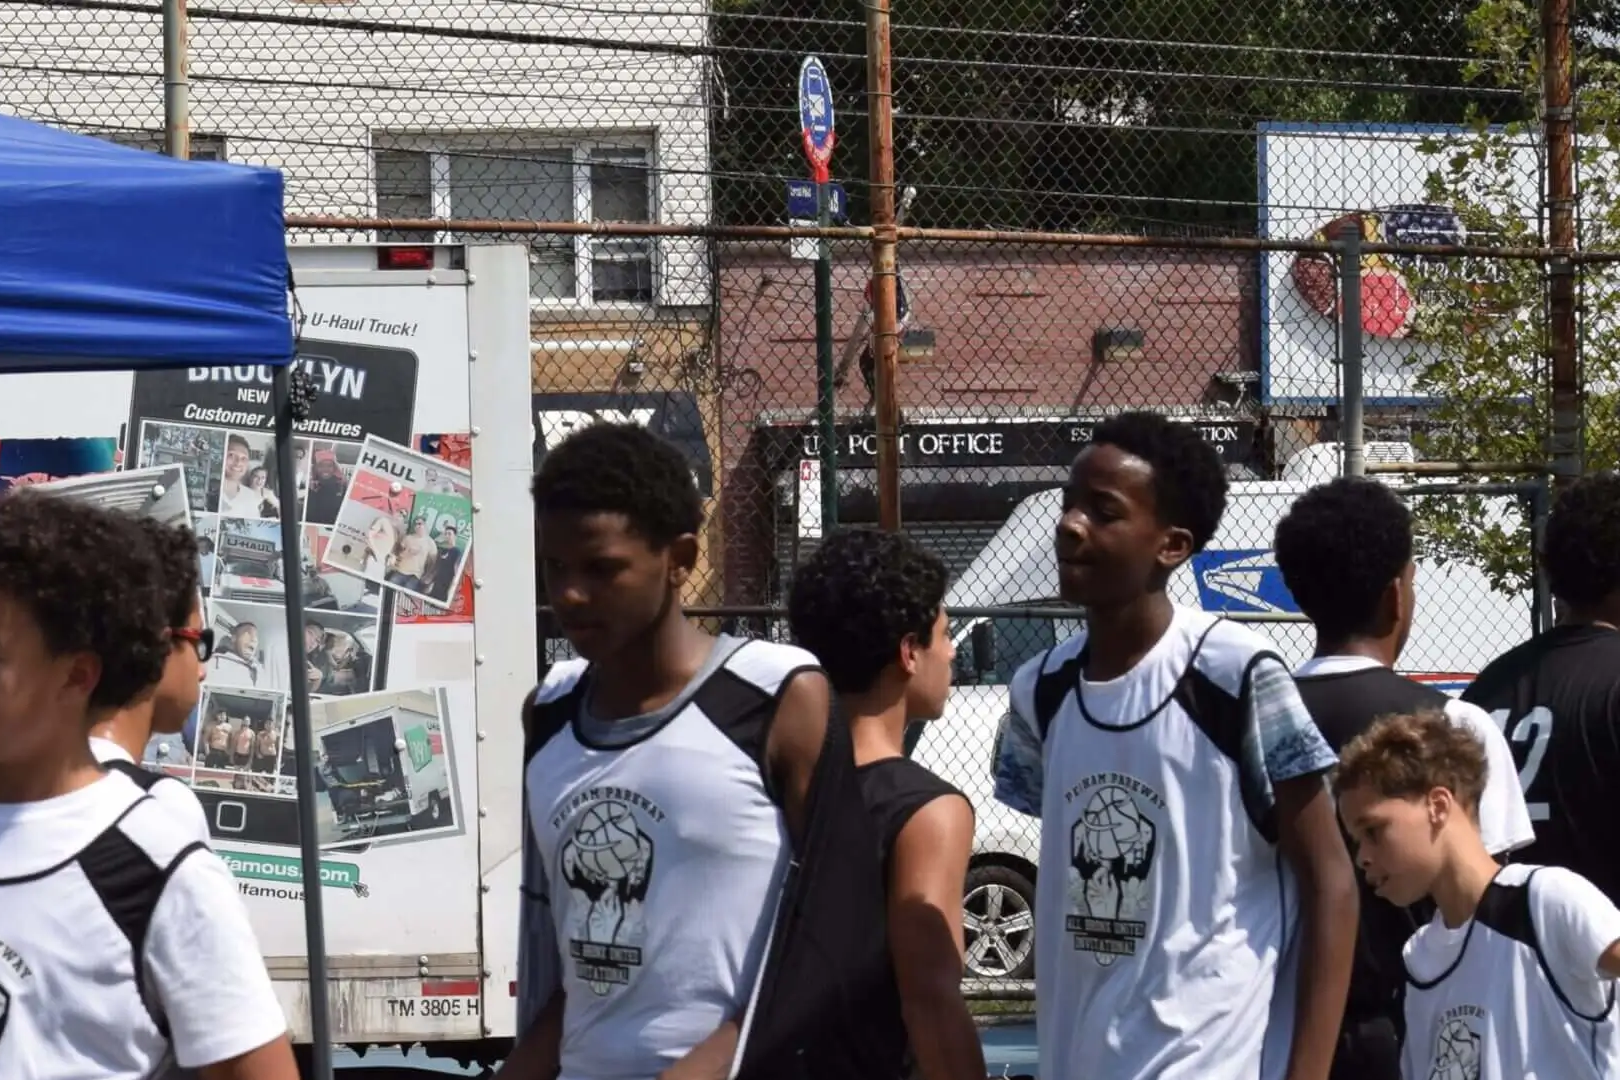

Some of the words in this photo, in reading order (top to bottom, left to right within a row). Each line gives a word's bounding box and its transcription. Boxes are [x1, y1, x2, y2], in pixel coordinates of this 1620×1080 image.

[311, 311, 365, 331] U-Haul
[369, 318, 418, 337] Truck!
[237, 388, 270, 404] NEW
[184, 403, 265, 427] Customer
[268, 415, 362, 438] Aventures
[848, 433, 910, 455] POT
[919, 433, 1004, 455] OFFICE
[361, 451, 417, 483] HAUL
[388, 999, 415, 1017] TM
[420, 998, 461, 1017] 3805
[467, 998, 479, 1016] H
